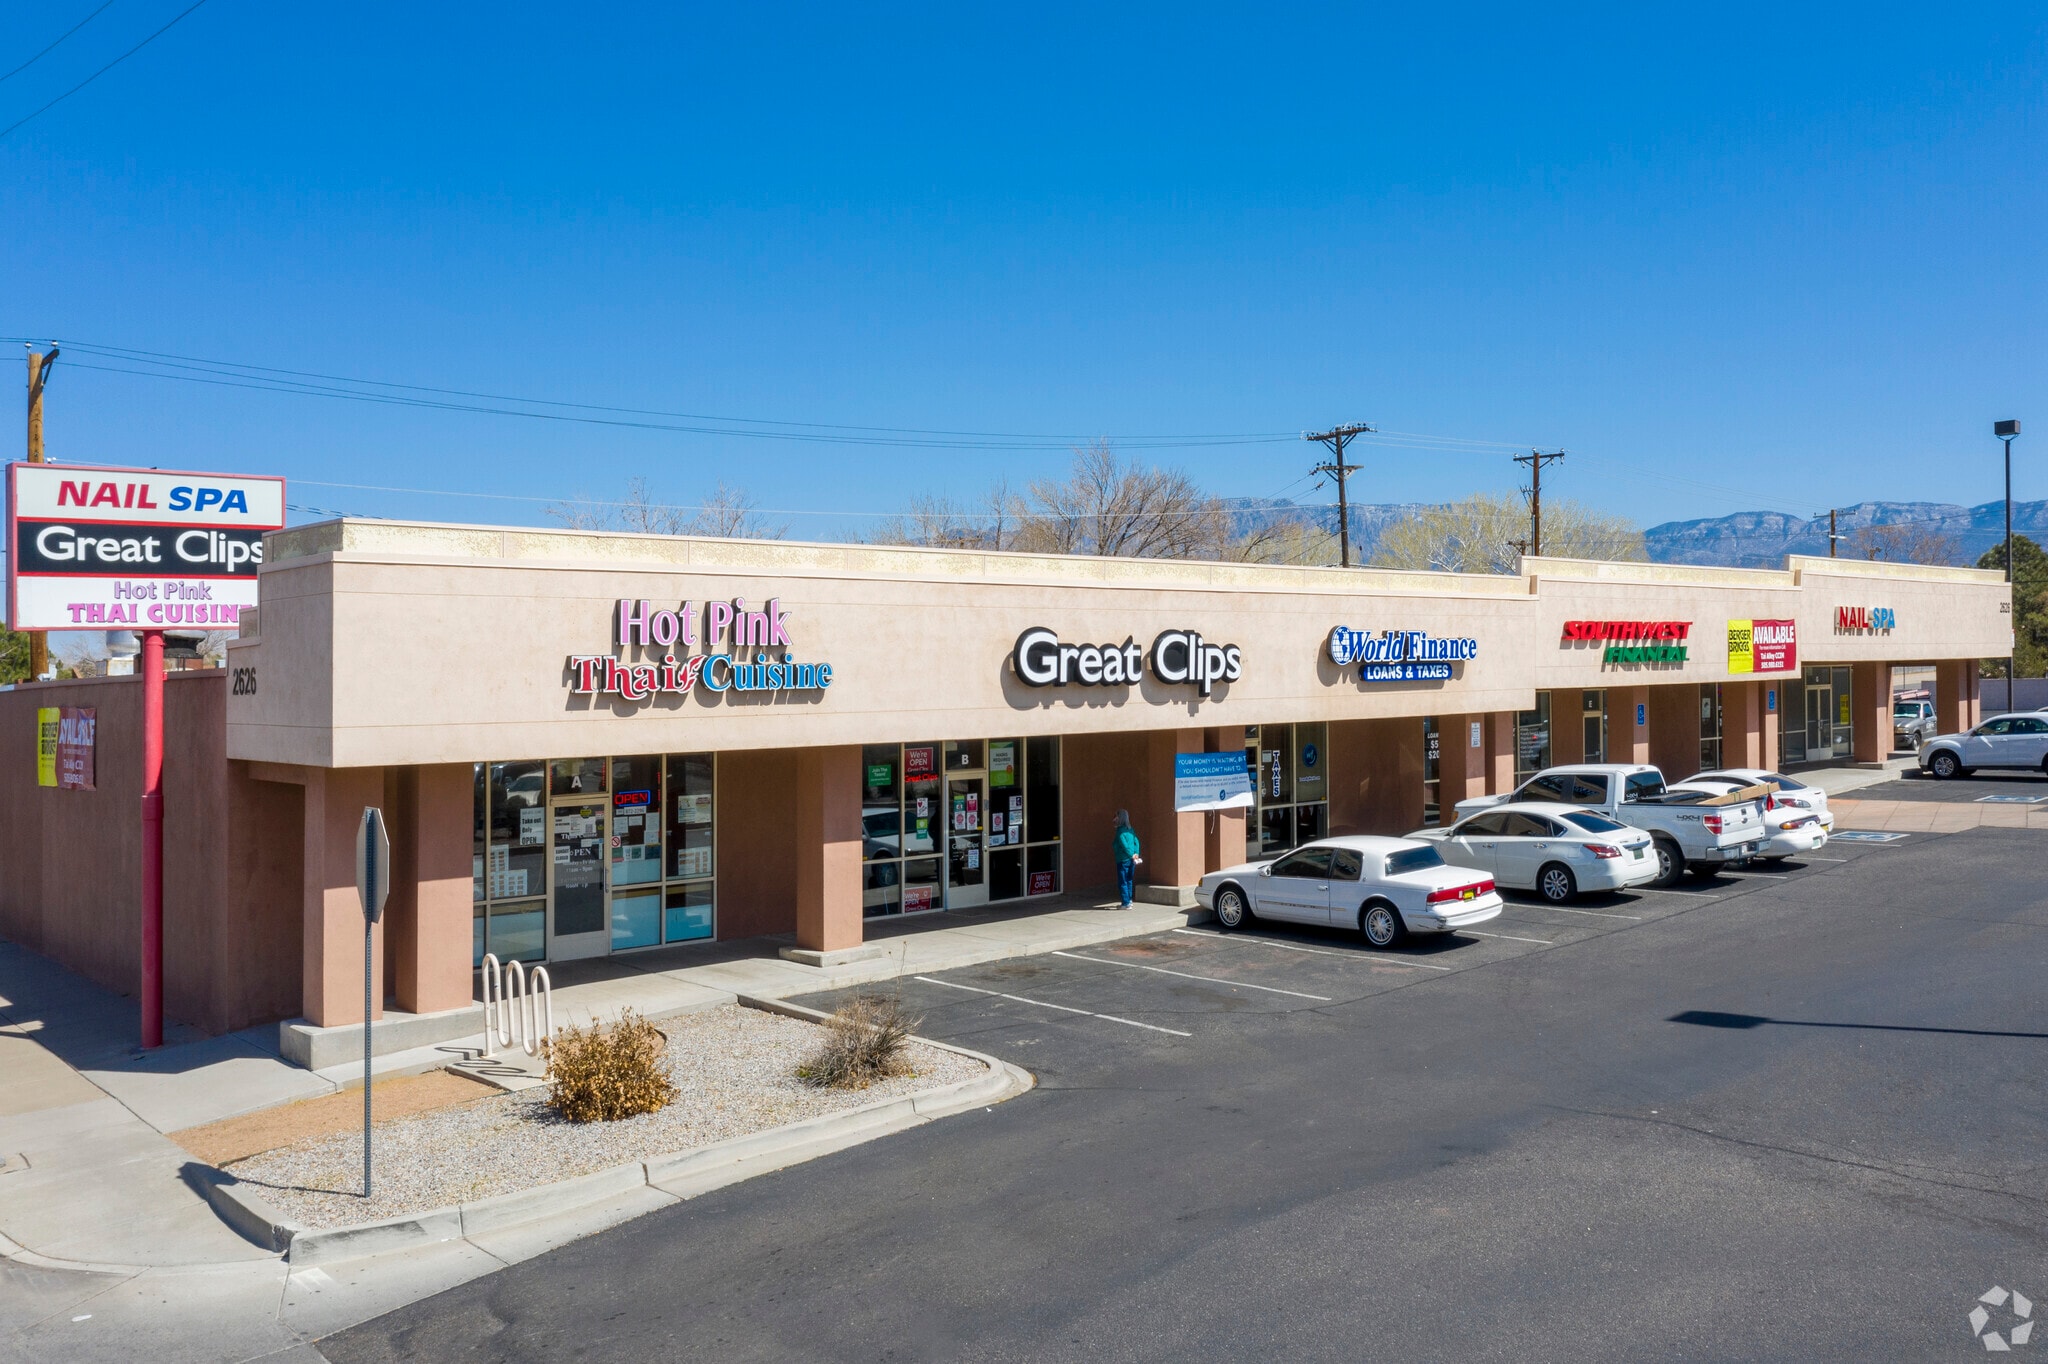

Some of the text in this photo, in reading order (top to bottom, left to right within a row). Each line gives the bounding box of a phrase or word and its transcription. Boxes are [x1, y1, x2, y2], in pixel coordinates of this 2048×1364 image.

[57, 480, 248, 513] NAIL SPA
[37, 525, 263, 573] Great Clips
[114, 580, 212, 600] Hot Pink
[67, 603, 252, 624] THAI CUISIN
[618, 597, 792, 646] Hot Pink
[1839, 606, 1896, 629] NAIL SPA
[1561, 620, 1693, 641] SOUTHWEST
[1728, 629, 1751, 641] BERGER
[1753, 625, 1795, 644] AVAILABLE
[1349, 630, 1477, 662] World Finance
[1604, 646, 1691, 663] FINANCIAL
[1728, 641, 1750, 653] BRIGGS
[1017, 629, 1242, 694] Great Clips
[1367, 664, 1449, 679] LOANS & TAXES
[232, 667, 257, 696] 2626
[571, 653, 833, 700] Thai Cuisine
[1588, 700, 1593, 708] E
[909, 750, 927, 758] We're
[961, 754, 970, 765] B
[571, 776, 582, 788] A
[1272, 750, 1281, 797] TAXES
[614, 793, 648, 804] OPEN
[522, 837, 537, 845] OPEN
